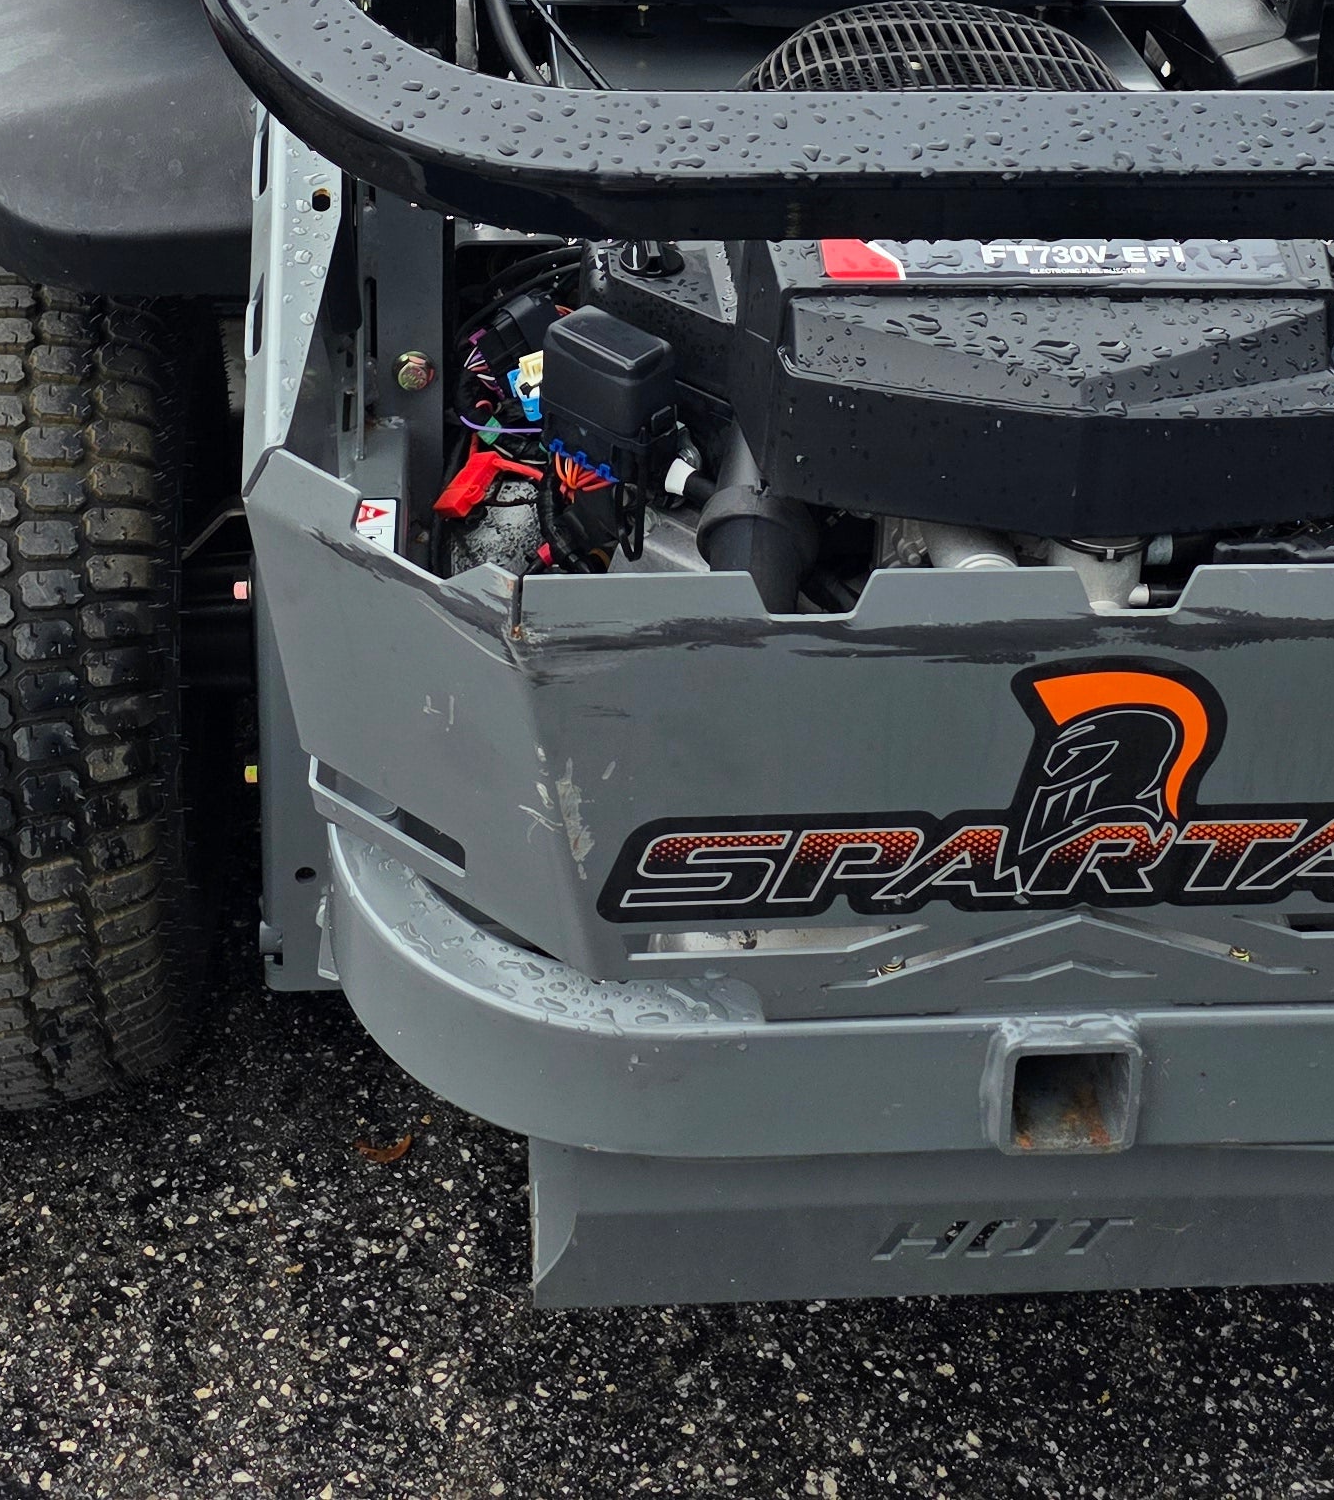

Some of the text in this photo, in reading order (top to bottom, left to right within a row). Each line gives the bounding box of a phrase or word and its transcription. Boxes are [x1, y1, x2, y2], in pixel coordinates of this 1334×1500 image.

[980, 244, 1186, 266] FT730V EFI
[1029, 267, 1081, 275] ELECTRONIC
[1081, 267, 1103, 275] FUEL
[871, 1216, 1137, 1261] HOT
